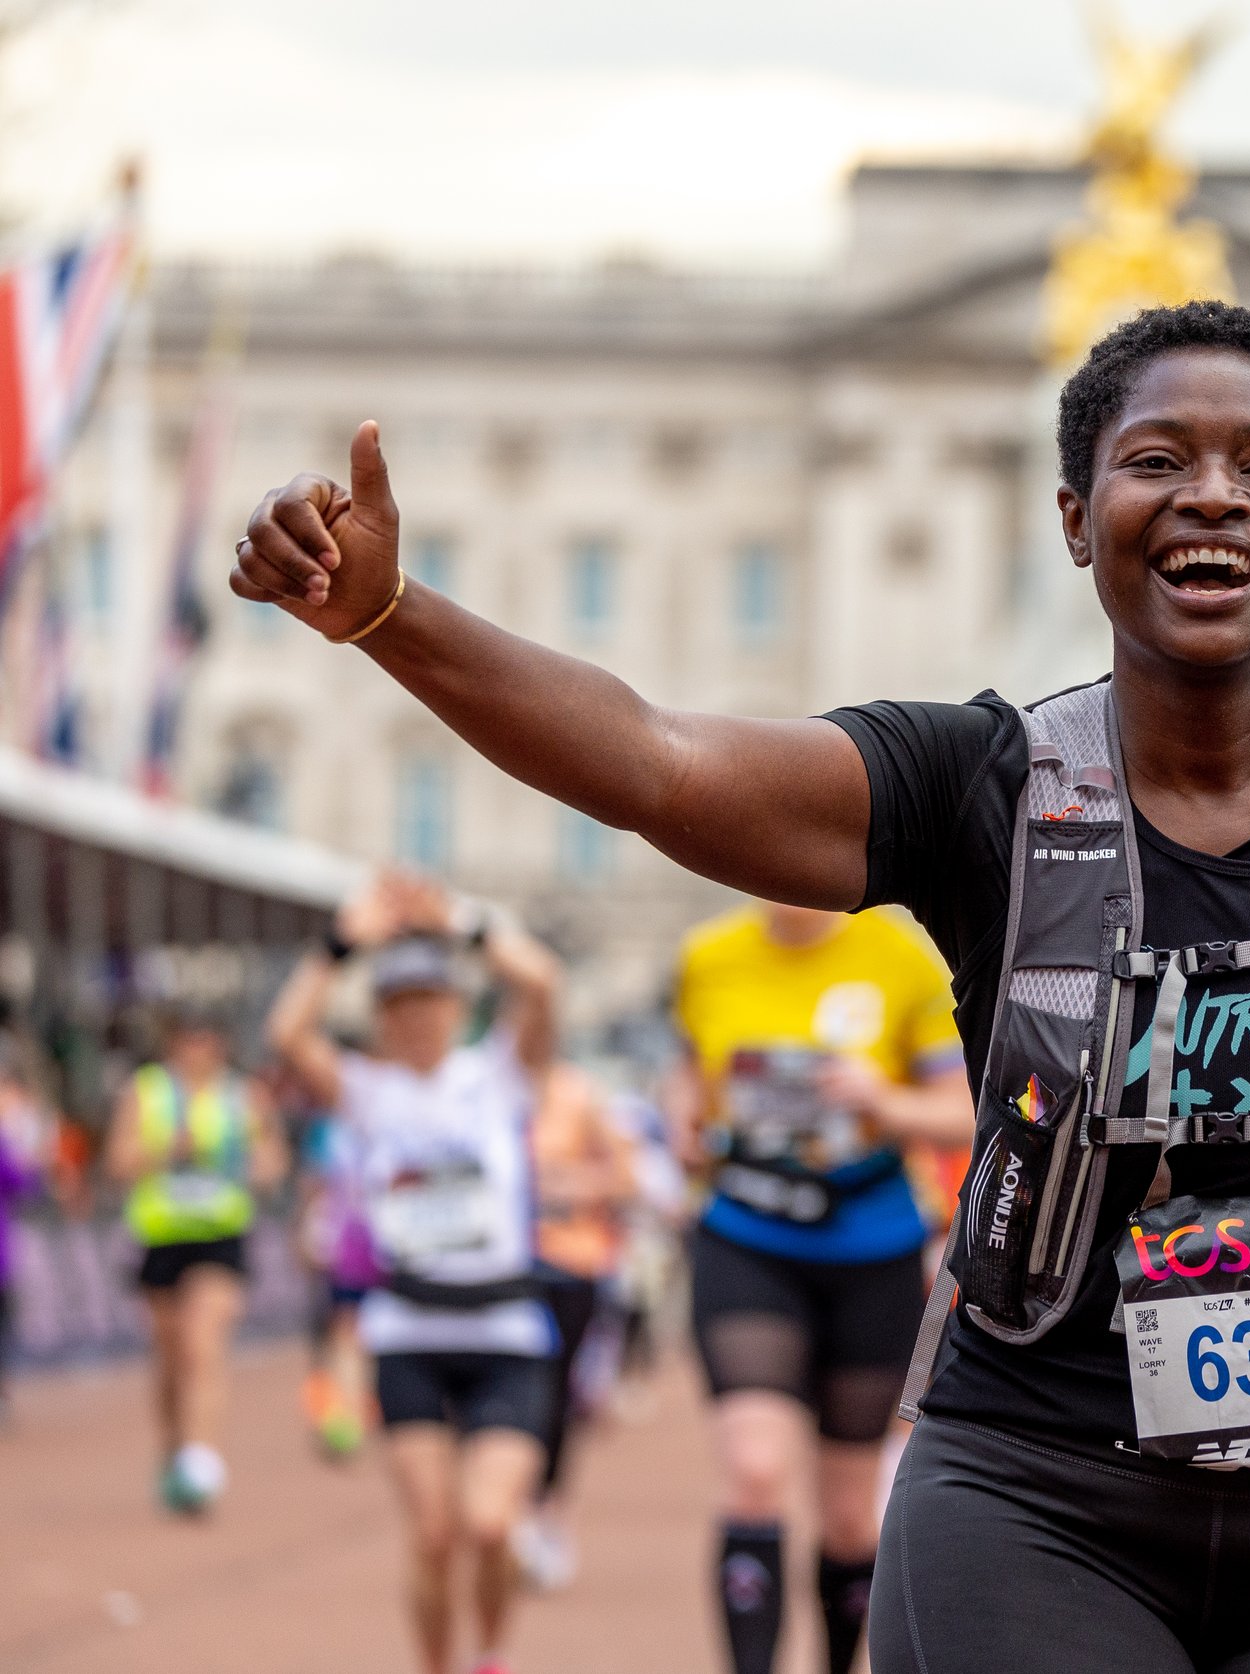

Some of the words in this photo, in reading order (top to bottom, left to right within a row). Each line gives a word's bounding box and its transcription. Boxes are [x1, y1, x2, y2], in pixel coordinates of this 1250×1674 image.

[1033, 848, 1048, 860] AIR
[1051, 849, 1075, 861] WIND
[1077, 848, 1117, 861] TRACKER
[989, 1151, 1023, 1250] AONIJIE
[1139, 1337, 1163, 1346] WAVE
[1139, 1360, 1166, 1369] LORRY
[1149, 1369, 1158, 1377] 36
